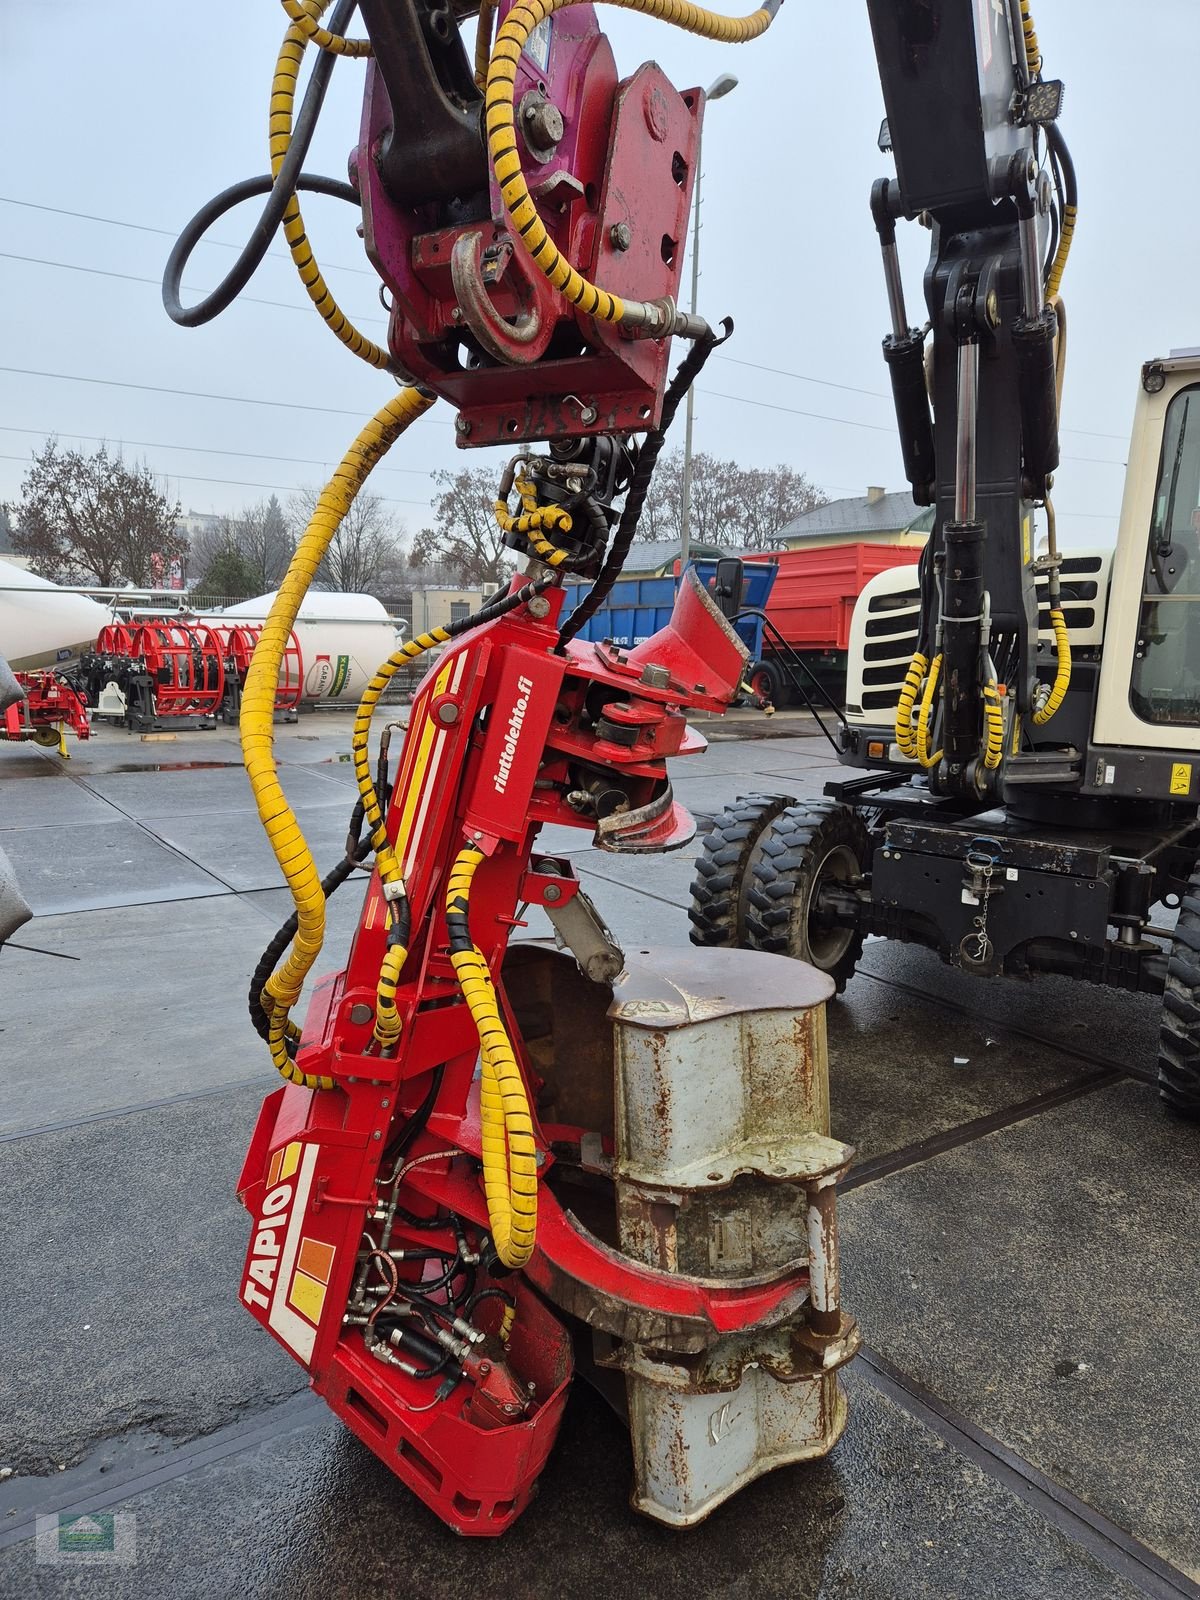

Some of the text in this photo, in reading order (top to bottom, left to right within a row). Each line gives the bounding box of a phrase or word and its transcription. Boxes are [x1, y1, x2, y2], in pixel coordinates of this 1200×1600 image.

[317, 664, 329, 692] GARANT
[494, 675, 533, 794] riuttolehto.fi
[243, 1184, 292, 1310] TAPIO
